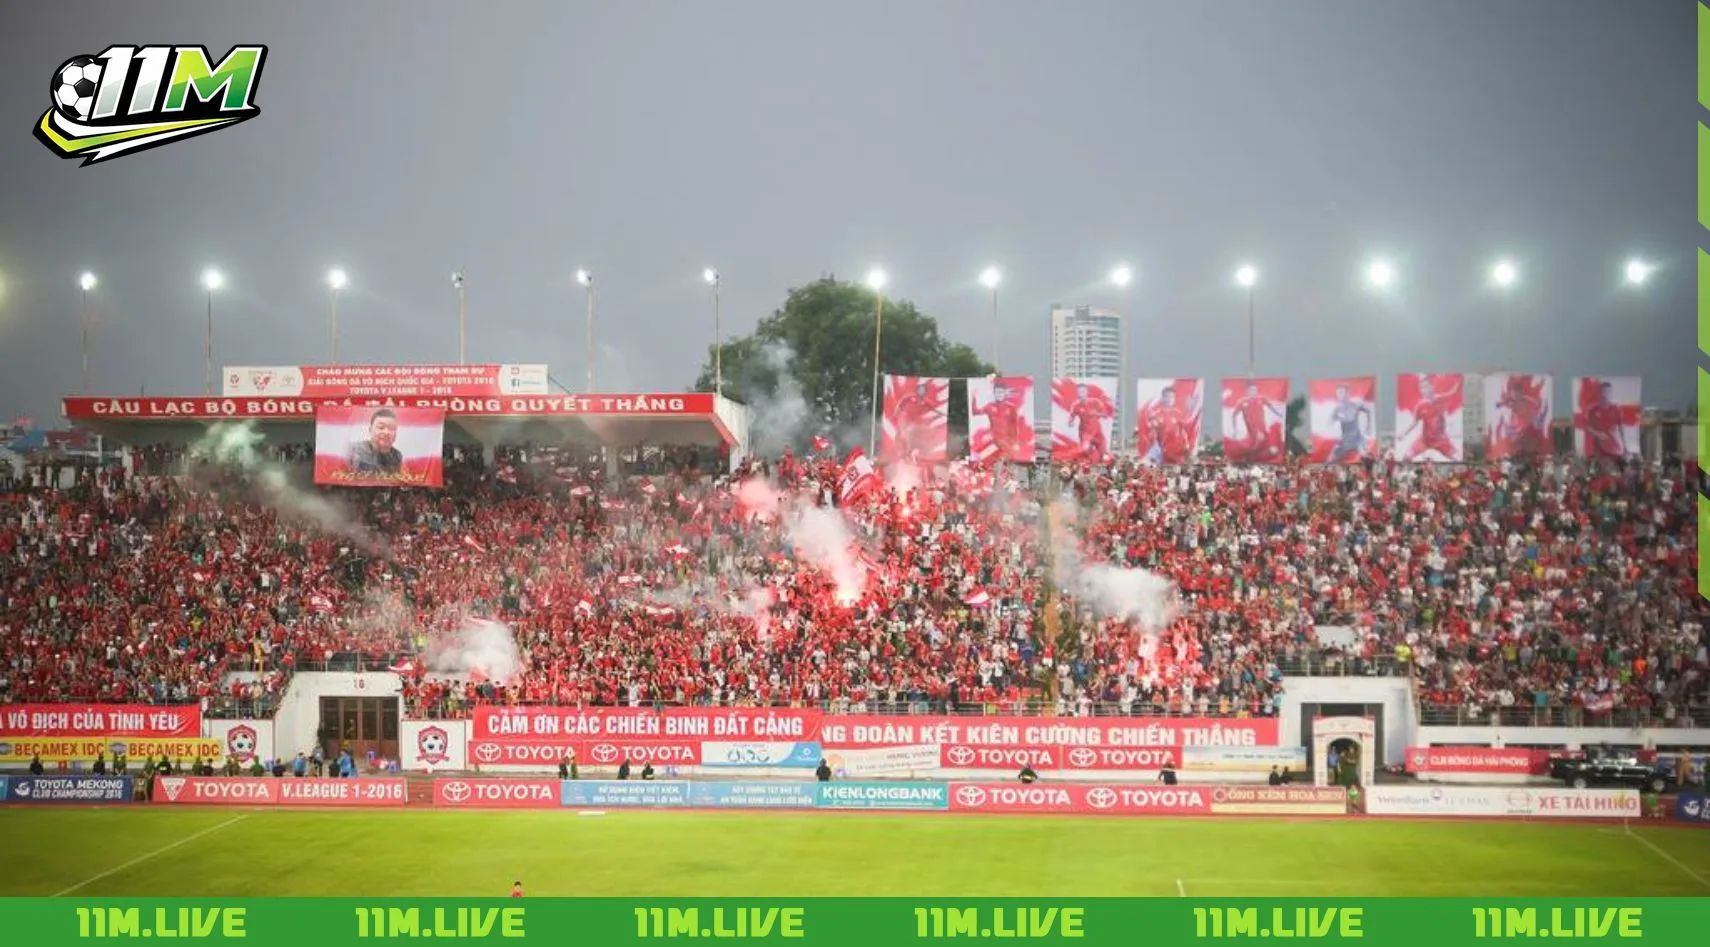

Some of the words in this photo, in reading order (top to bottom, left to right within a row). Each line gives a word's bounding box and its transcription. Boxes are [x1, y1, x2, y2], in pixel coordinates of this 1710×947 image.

[93, 398, 140, 414] CÂU
[151, 400, 195, 416] LẠC
[206, 399, 236, 416] BỘ
[247, 397, 313, 413] BÓNG
[512, 396, 591, 412] QUYẾT
[596, 395, 684, 411] THẮNG
[32, 711, 68, 733] ĐỊCH
[73, 707, 104, 730] CỦA
[108, 709, 144, 730] TÌNH
[150, 709, 178, 731] YÊU
[488, 711, 528, 735] CẢM
[534, 712, 559, 735] ƠN
[565, 711, 600, 735] CÁC
[605, 711, 659, 735] CHIẾN
[714, 711, 748, 736] ĐẤT
[753, 713, 803, 736] CẢNG
[853, 721, 913, 744] ĐOÀN
[920, 720, 960, 744] KẾT
[967, 722, 1018, 744] KIÊN
[1025, 721, 1101, 745] CƯỜNG
[1108, 721, 1175, 745] CHIẾN
[1181, 722, 1256, 746] THẮNG
[14, 742, 78, 757] BECAMEX
[82, 742, 104, 757] IDC
[129, 742, 192, 758] BECAMEX
[199, 743, 220, 757] IDC
[505, 745, 576, 760] TOYOTA
[622, 746, 695, 761] TOYOTA
[979, 749, 1053, 765] TOYOTA
[1102, 750, 1175, 765] TOYOTA
[34, 779, 73, 789] TOYOTA
[77, 779, 123, 789] MEKONG
[193, 781, 270, 798] TOYOTA
[282, 783, 348, 798] V.LEAGUE
[353, 783, 402, 799] 1-2016
[476, 784, 553, 800] TOYOTA
[822, 786, 943, 800] KIENLONGBANK
[990, 788, 1071, 805] TOYOTA
[1121, 790, 1203, 807] TOYOTA
[1538, 796, 1560, 809] XE
[1595, 796, 1637, 811] HINO
